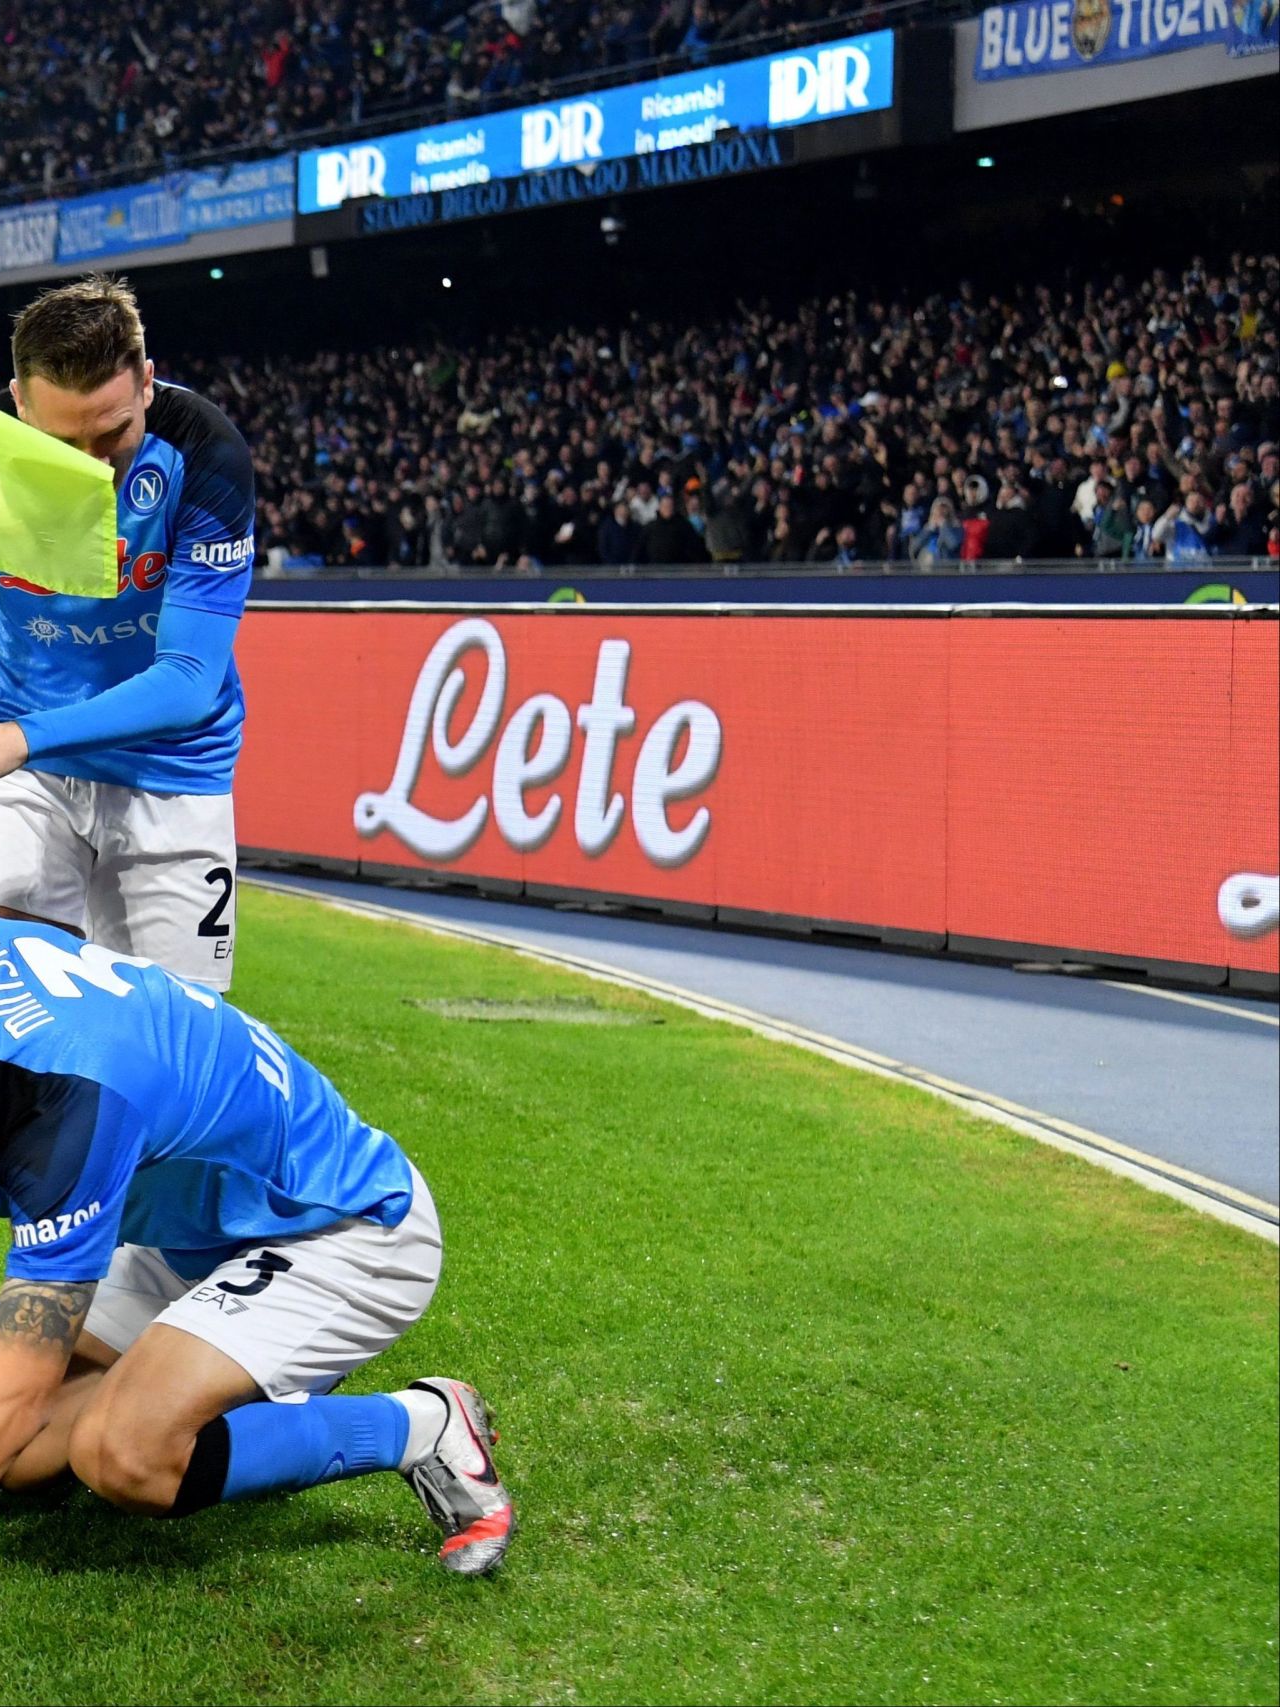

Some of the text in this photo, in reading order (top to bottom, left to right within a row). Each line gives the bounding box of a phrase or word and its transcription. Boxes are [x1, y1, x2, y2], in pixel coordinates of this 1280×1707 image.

[981, 4, 1070, 70] BLUE
[641, 78, 725, 122] Ricambi
[416, 128, 487, 165] Ricambi
[634, 128, 656, 155] in
[362, 133, 783, 233] STADIO DIEGO ARMANDO MARADONA
[137, 476, 158, 502] N
[353, 617, 723, 870] Lete
[191, 1287, 250, 1316] EA7
